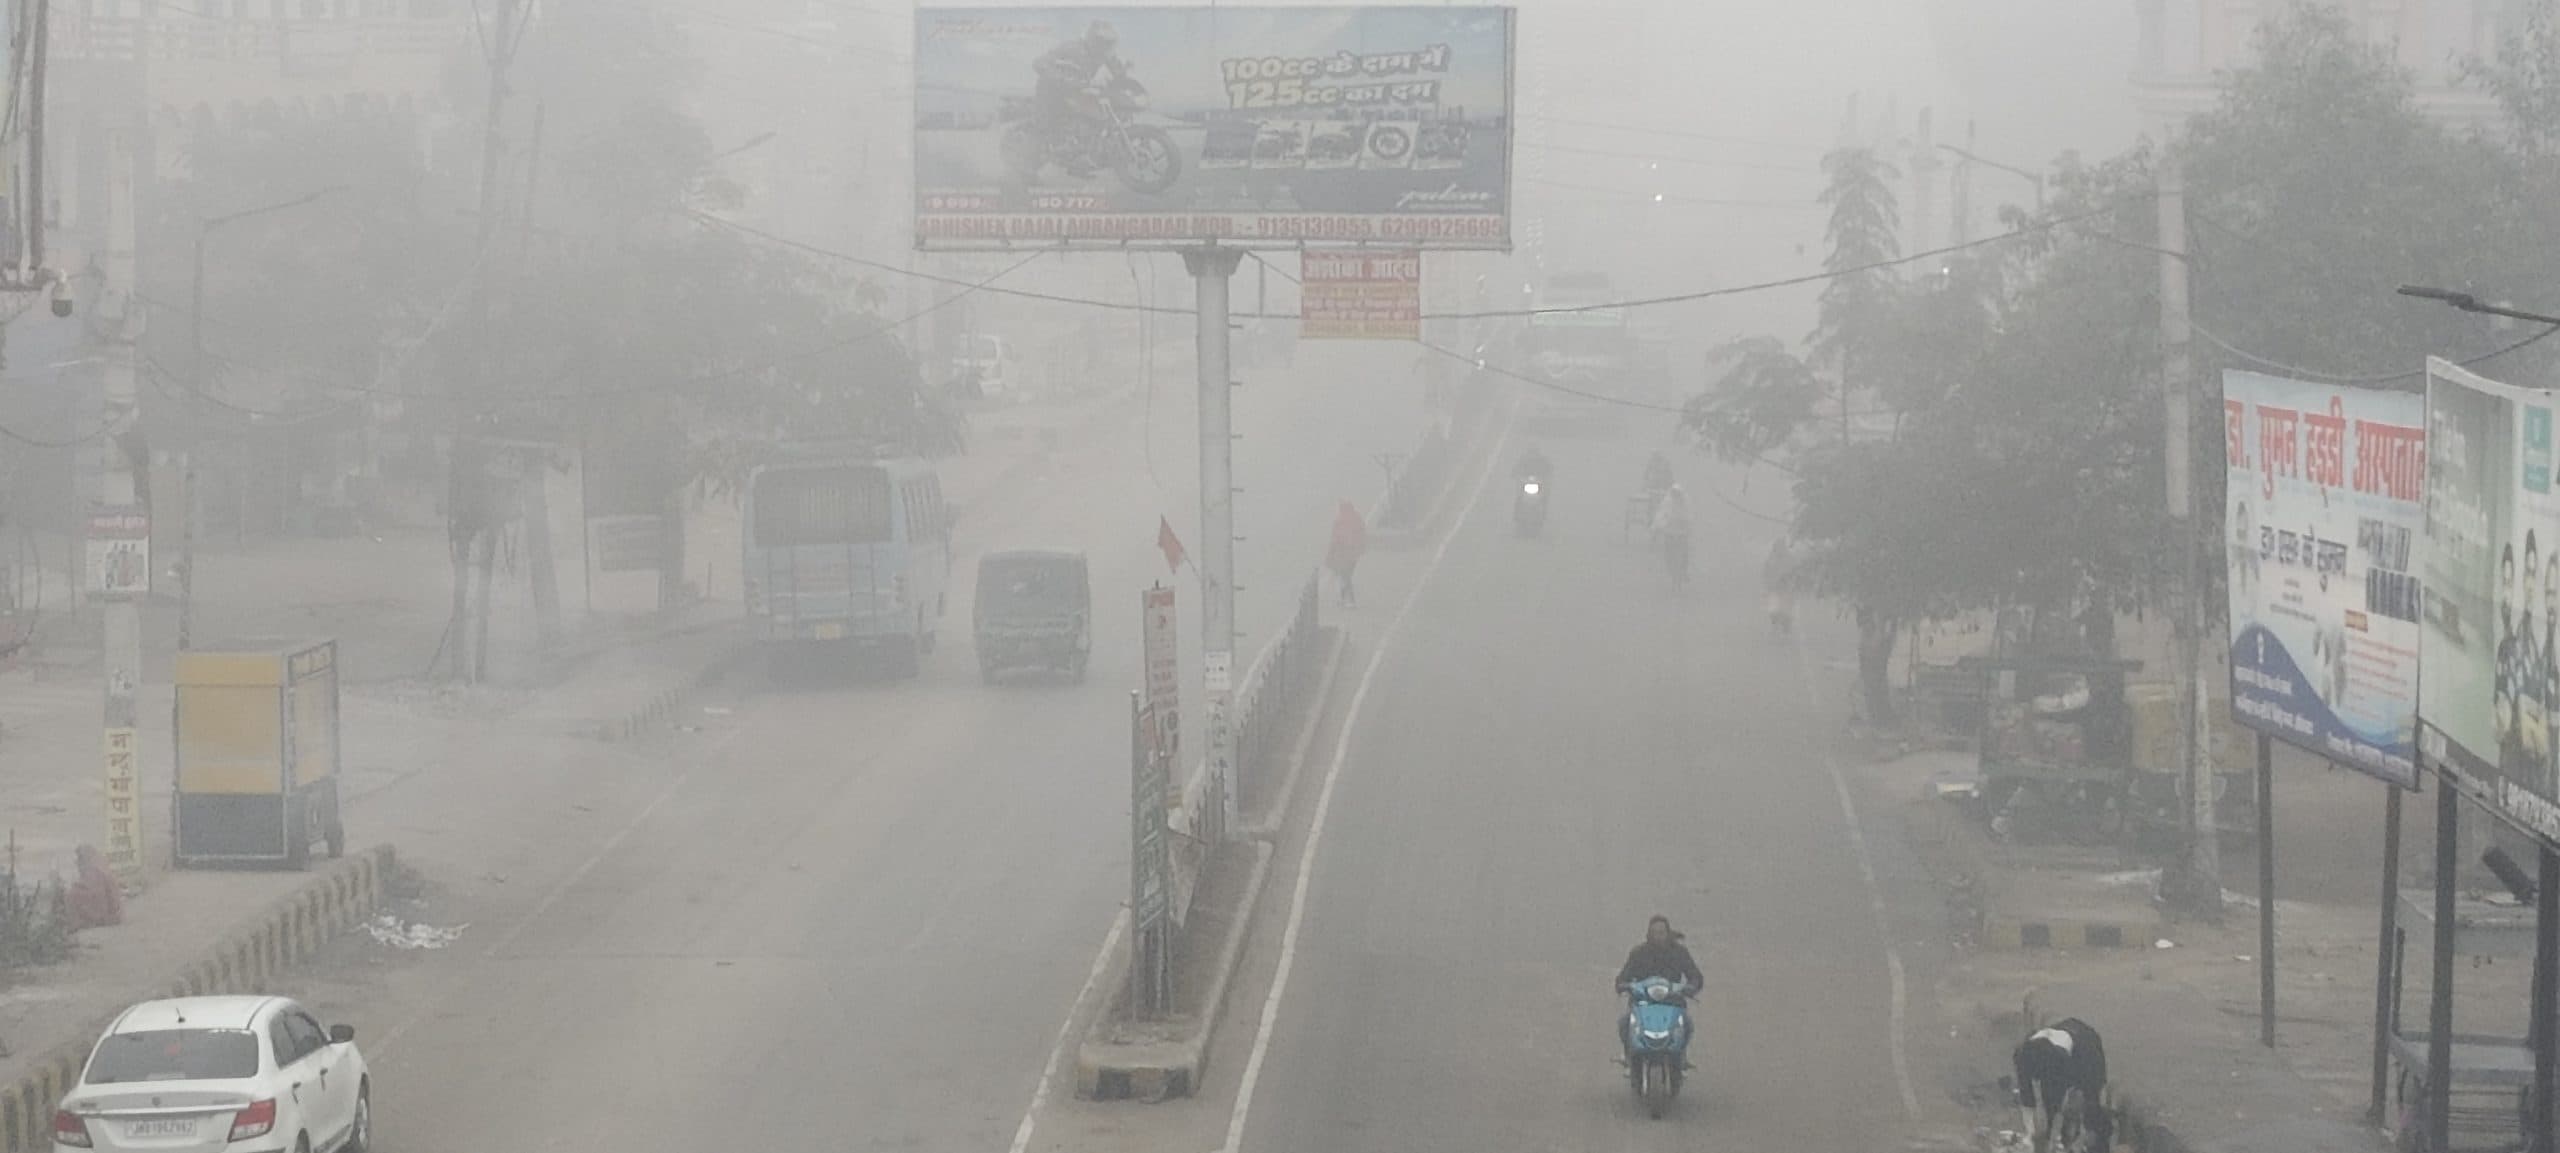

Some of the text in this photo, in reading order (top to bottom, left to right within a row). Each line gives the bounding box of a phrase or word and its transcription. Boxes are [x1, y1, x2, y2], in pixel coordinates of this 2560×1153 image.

[1222, 58, 1318, 80] 100cc
[1325, 51, 1354, 73] के
[1230, 82, 1338, 109] 125cc
